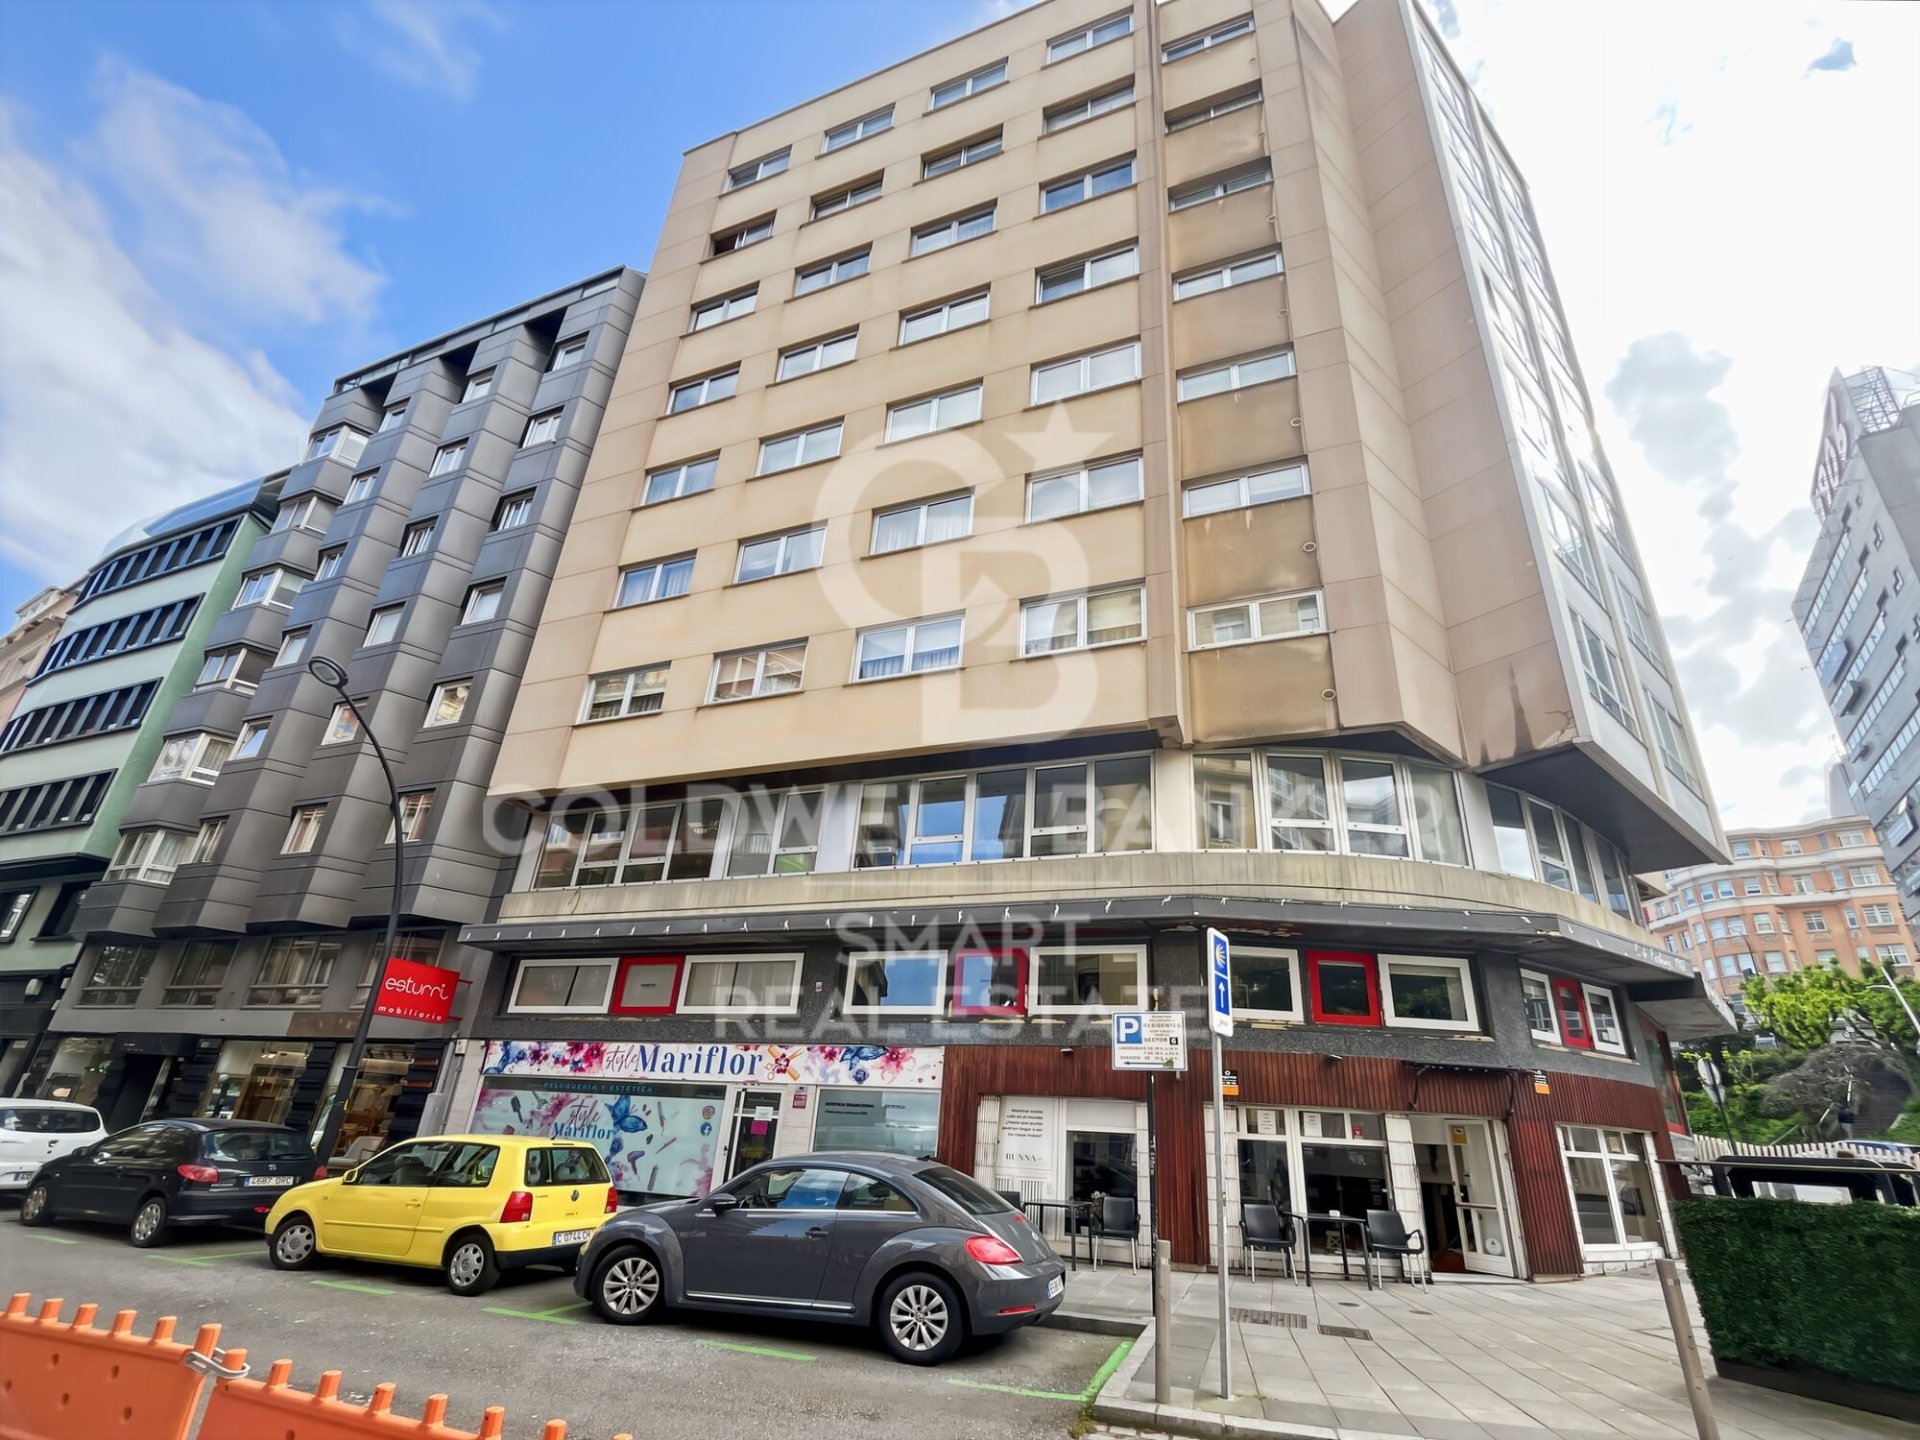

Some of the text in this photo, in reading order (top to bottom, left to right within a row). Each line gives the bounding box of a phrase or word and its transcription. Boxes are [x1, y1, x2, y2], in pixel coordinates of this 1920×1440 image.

[378, 1005, 442, 1021] mobiliario
[1119, 1017, 1139, 1042] P
[605, 1044, 763, 1076] style Mariflor
[566, 1098, 601, 1128] style
[553, 1121, 614, 1140] Mariflor
